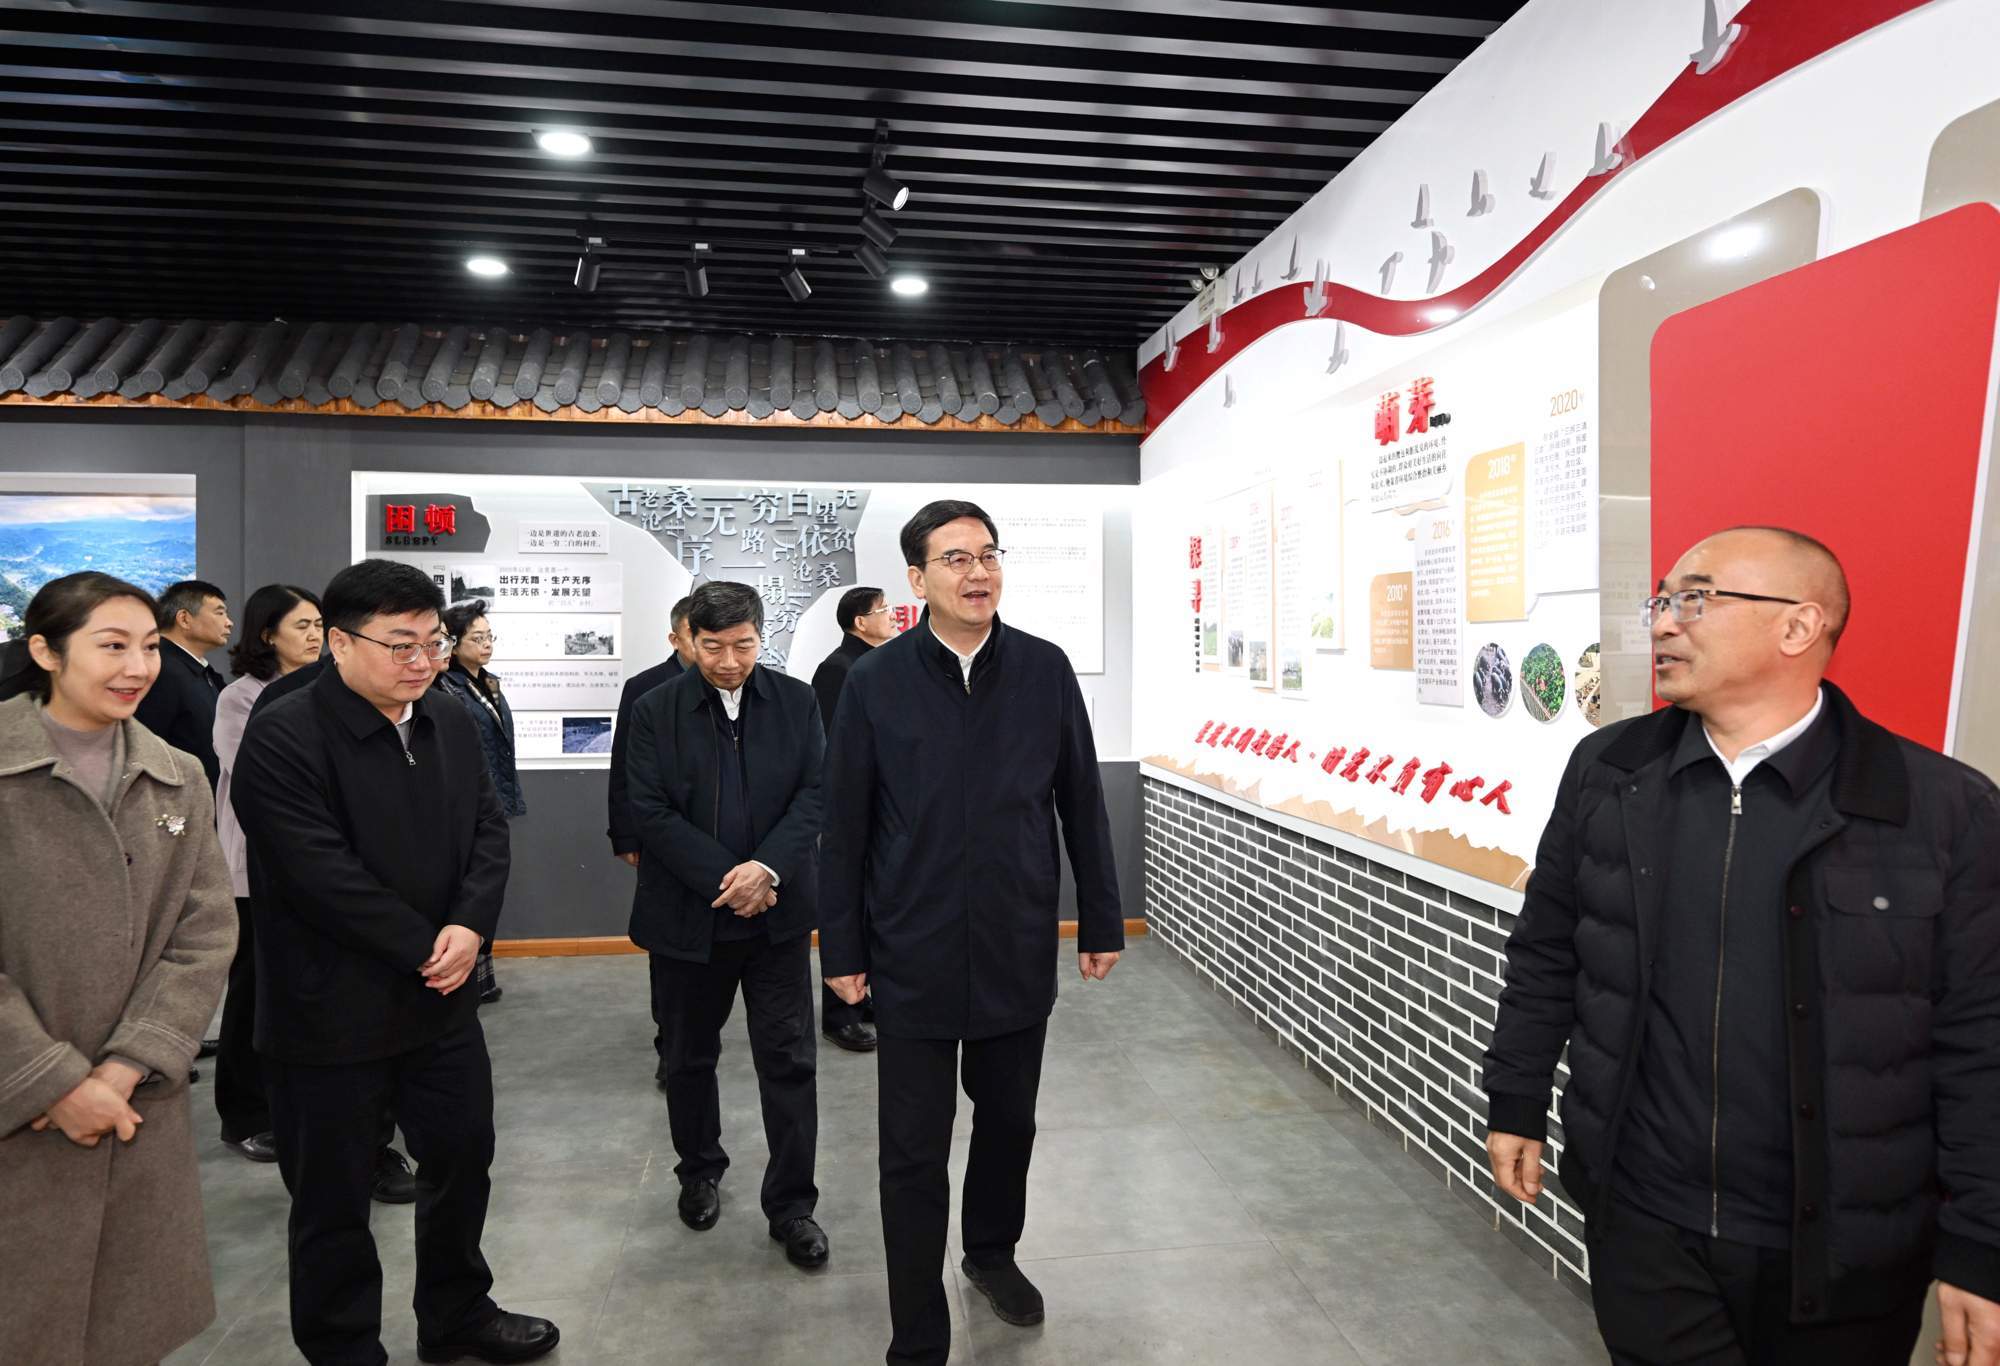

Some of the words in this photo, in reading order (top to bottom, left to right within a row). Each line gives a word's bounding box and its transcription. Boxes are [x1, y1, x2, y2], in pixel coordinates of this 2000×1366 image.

[662, 485, 698, 519] 桑
[748, 488, 784, 525] 穷
[788, 488, 813, 517] 白
[815, 501, 838, 526] 望
[837, 490, 857, 509] 无
[385, 503, 456, 536] 困顿
[702, 503, 738, 537] 无
[741, 527, 768, 554] 路
[797, 524, 831, 559] 依
[499, 575, 592, 585] 出行无路·生产无序
[816, 562, 841, 589] 桑
[499, 587, 592, 597] 生活无依·发展无望
